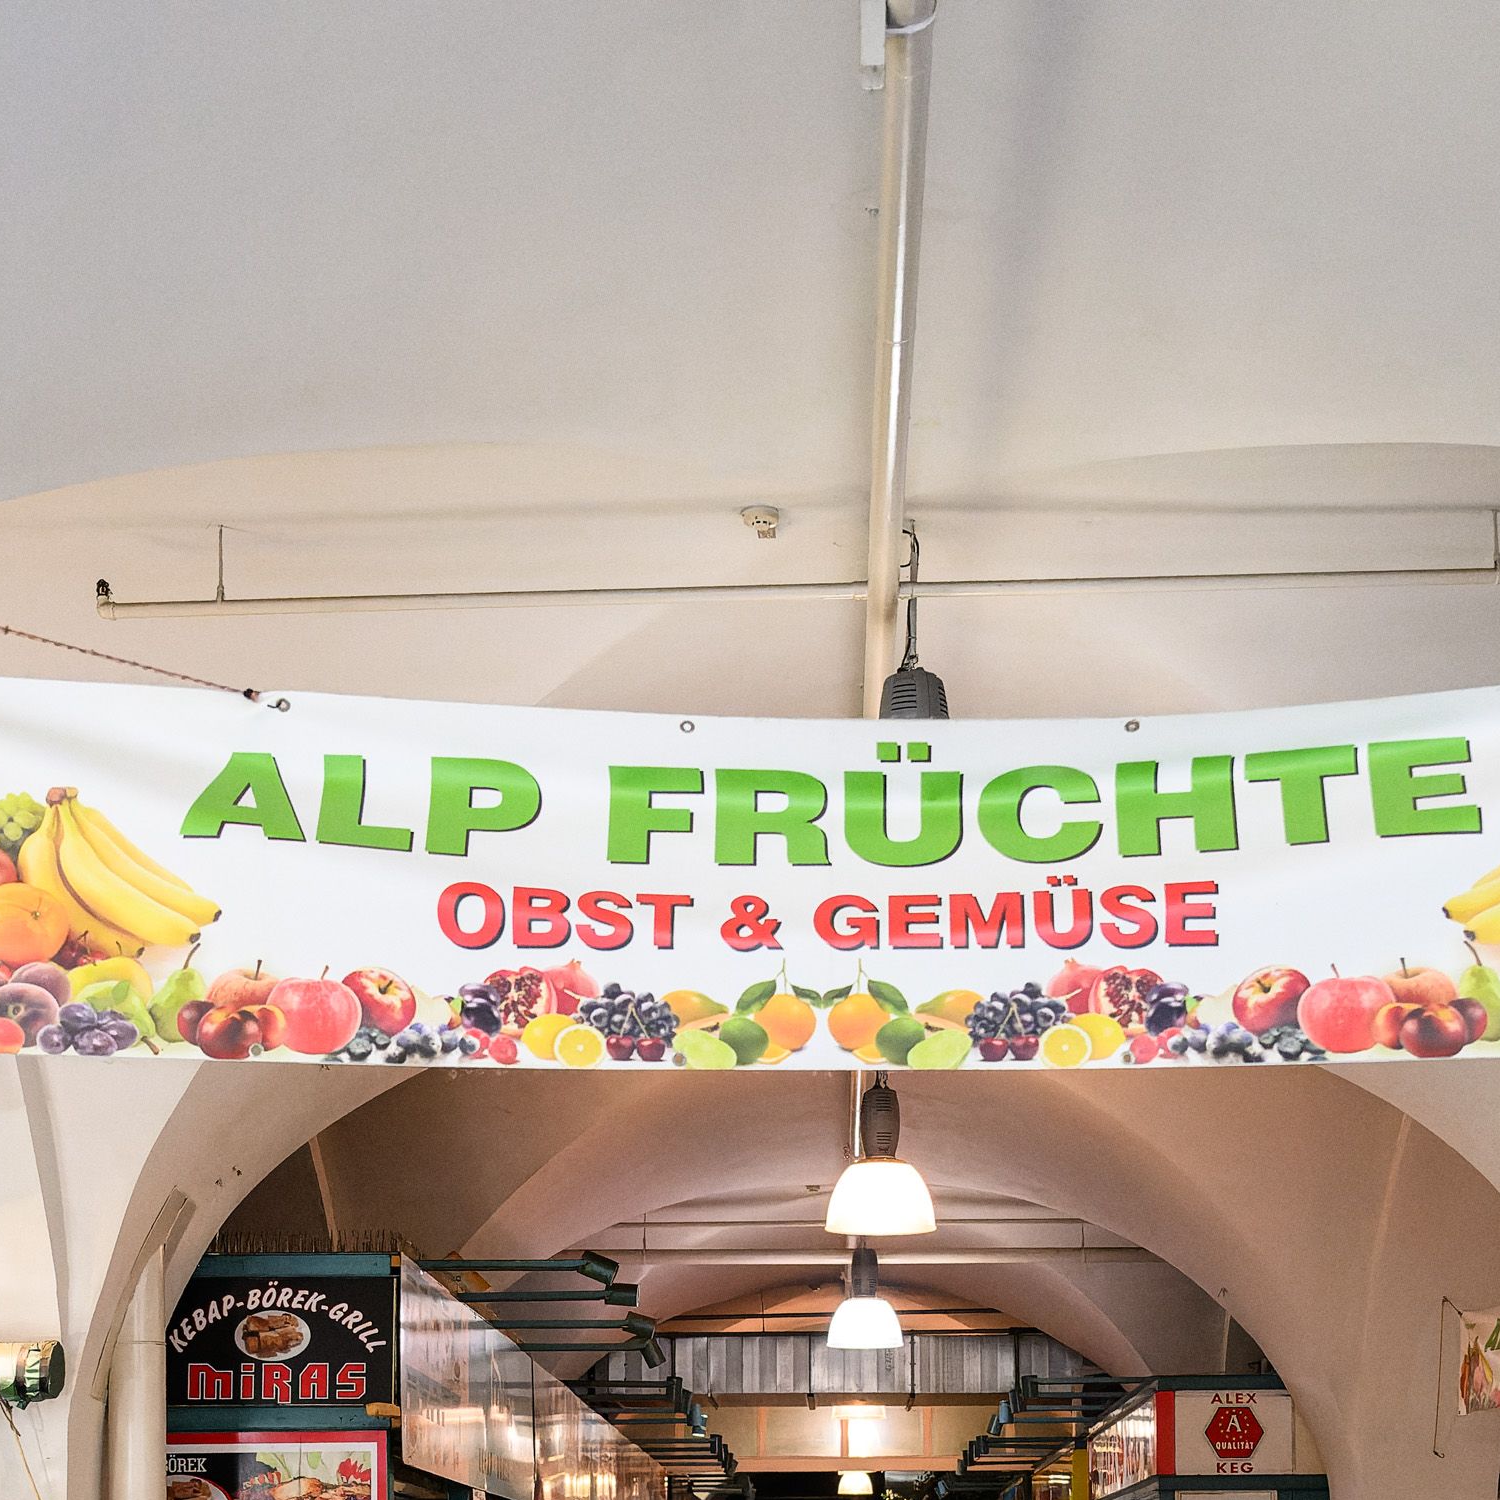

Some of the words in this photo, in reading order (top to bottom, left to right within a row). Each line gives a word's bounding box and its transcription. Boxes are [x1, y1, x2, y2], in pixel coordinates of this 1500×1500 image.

[179, 751, 542, 858] ALP
[607, 735, 1485, 868] FRÜCHTE
[437, 881, 695, 952] OBST
[718, 892, 785, 952] &
[813, 875, 1222, 951] GEMÜSE
[168, 1280, 388, 1354] KEBAP-BÖREK-GRILL
[1210, 1392, 1258, 1405] ALEX
[1226, 1414, 1242, 1433] A
[1215, 1440, 1254, 1450] QUALITÄT
[1216, 1462, 1254, 1474] KEG
